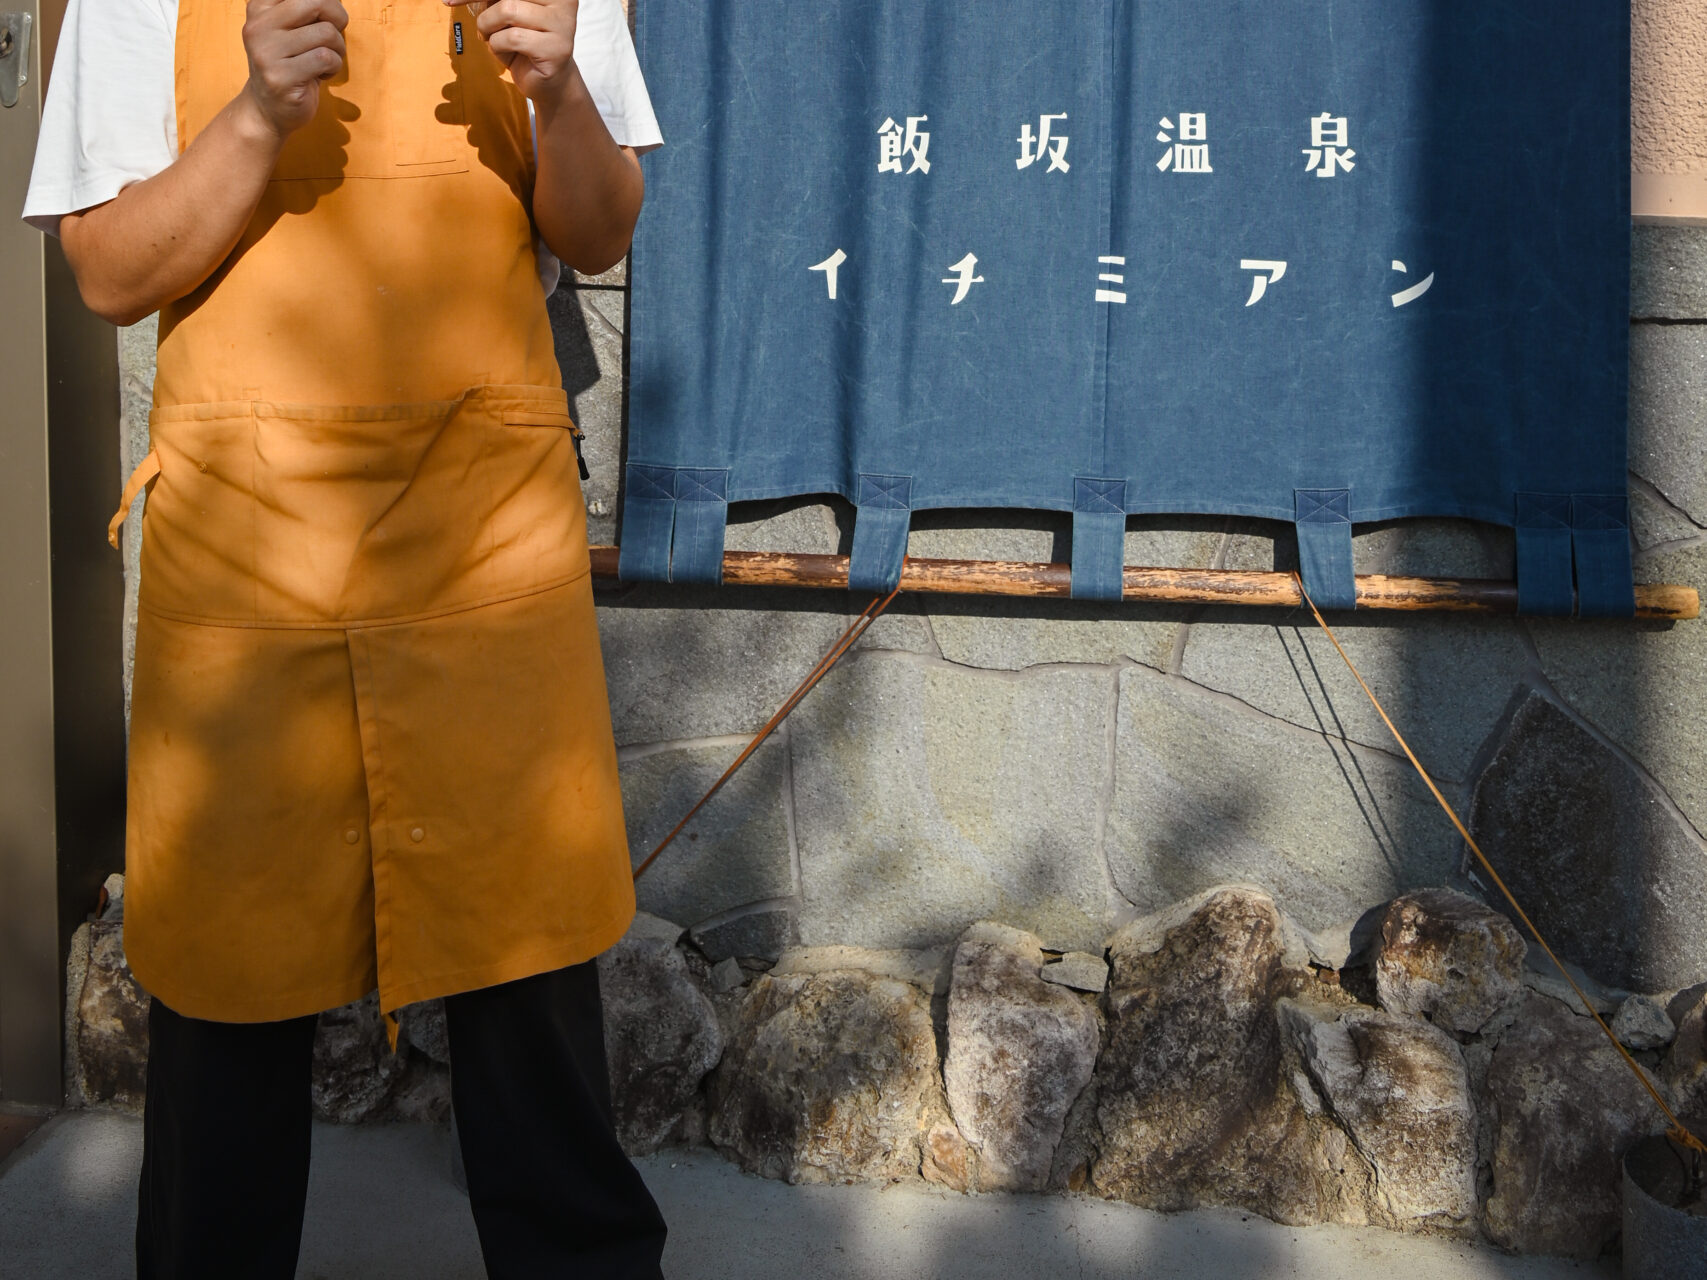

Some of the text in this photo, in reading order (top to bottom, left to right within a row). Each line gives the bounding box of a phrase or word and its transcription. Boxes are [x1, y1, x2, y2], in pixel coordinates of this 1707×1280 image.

[877, 112, 1356, 178] 飯坂温泉
[808, 249, 1434, 307] イチミアン
